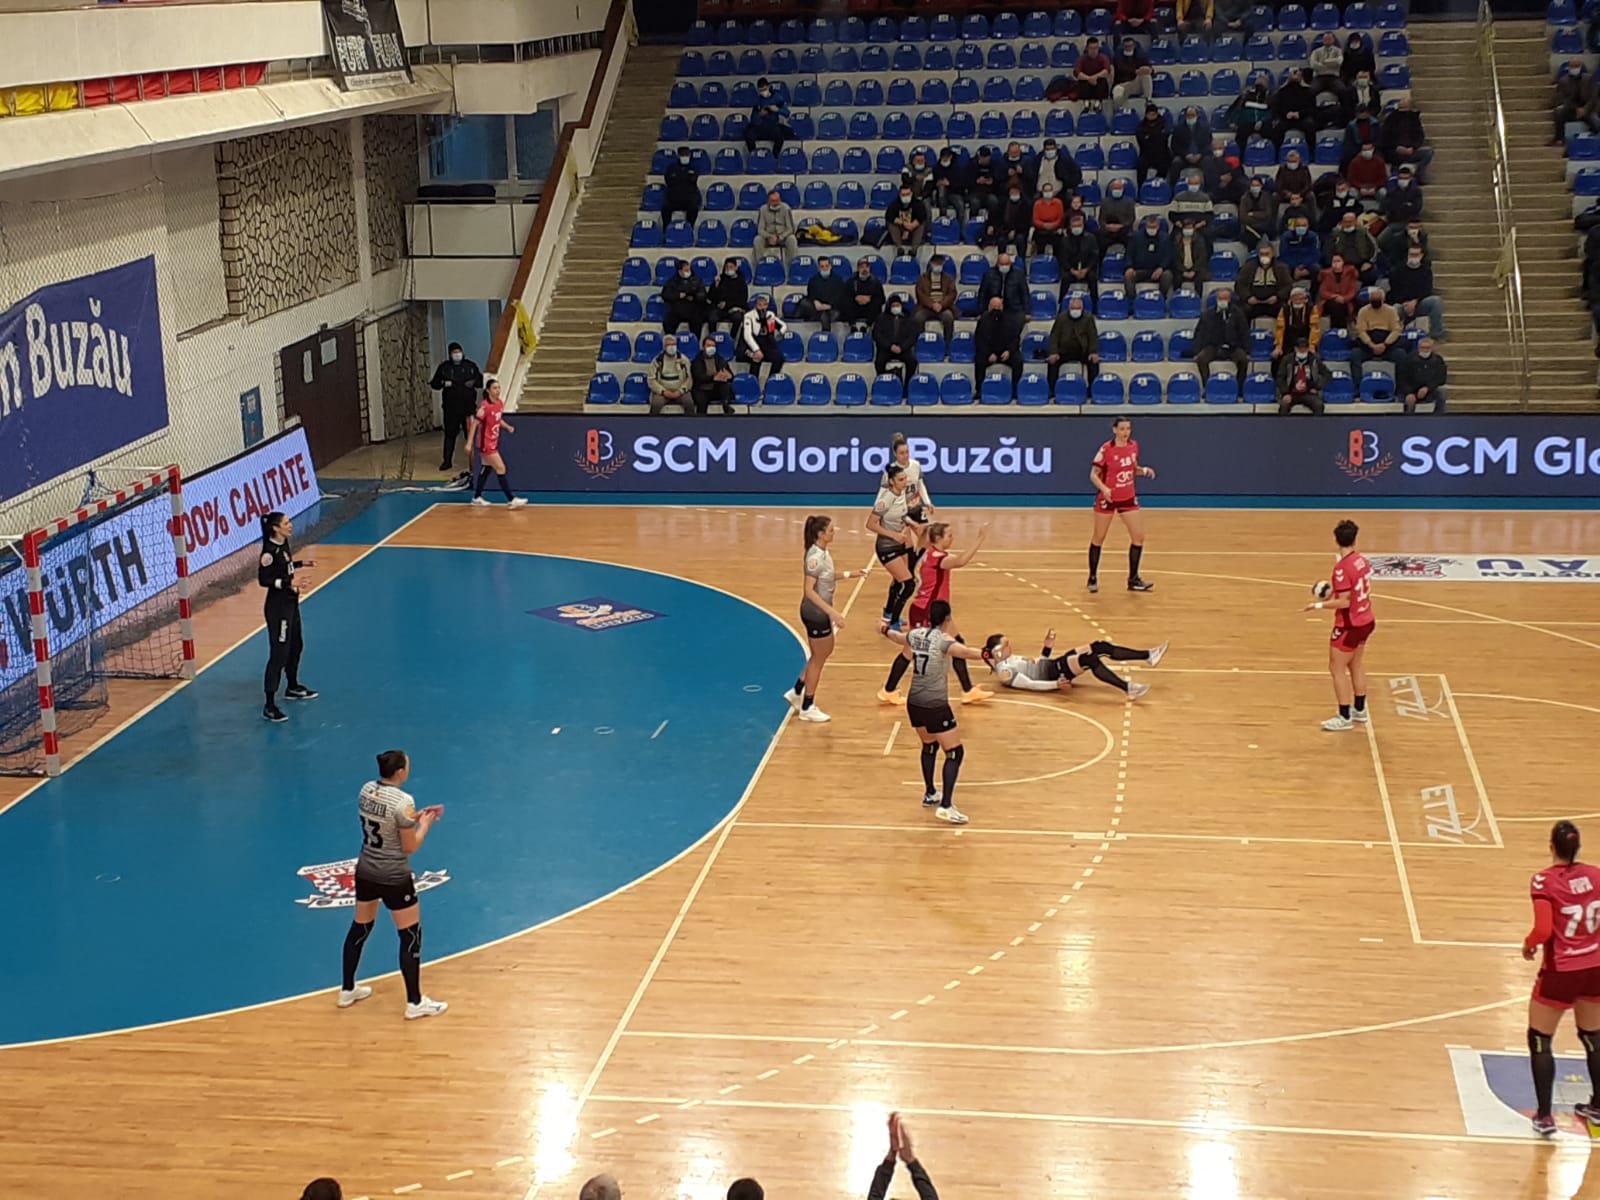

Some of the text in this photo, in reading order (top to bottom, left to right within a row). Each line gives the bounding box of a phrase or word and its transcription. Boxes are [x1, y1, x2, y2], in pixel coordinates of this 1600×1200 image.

[25, 297, 134, 399] Buzău
[632, 435, 737, 474] SCM
[751, 435, 890, 474] Gloria
[906, 435, 1052, 474] Buzău
[1400, 435, 1518, 475] SCM
[229, 453, 310, 528] CALITATE
[912, 652, 930, 676] 17
